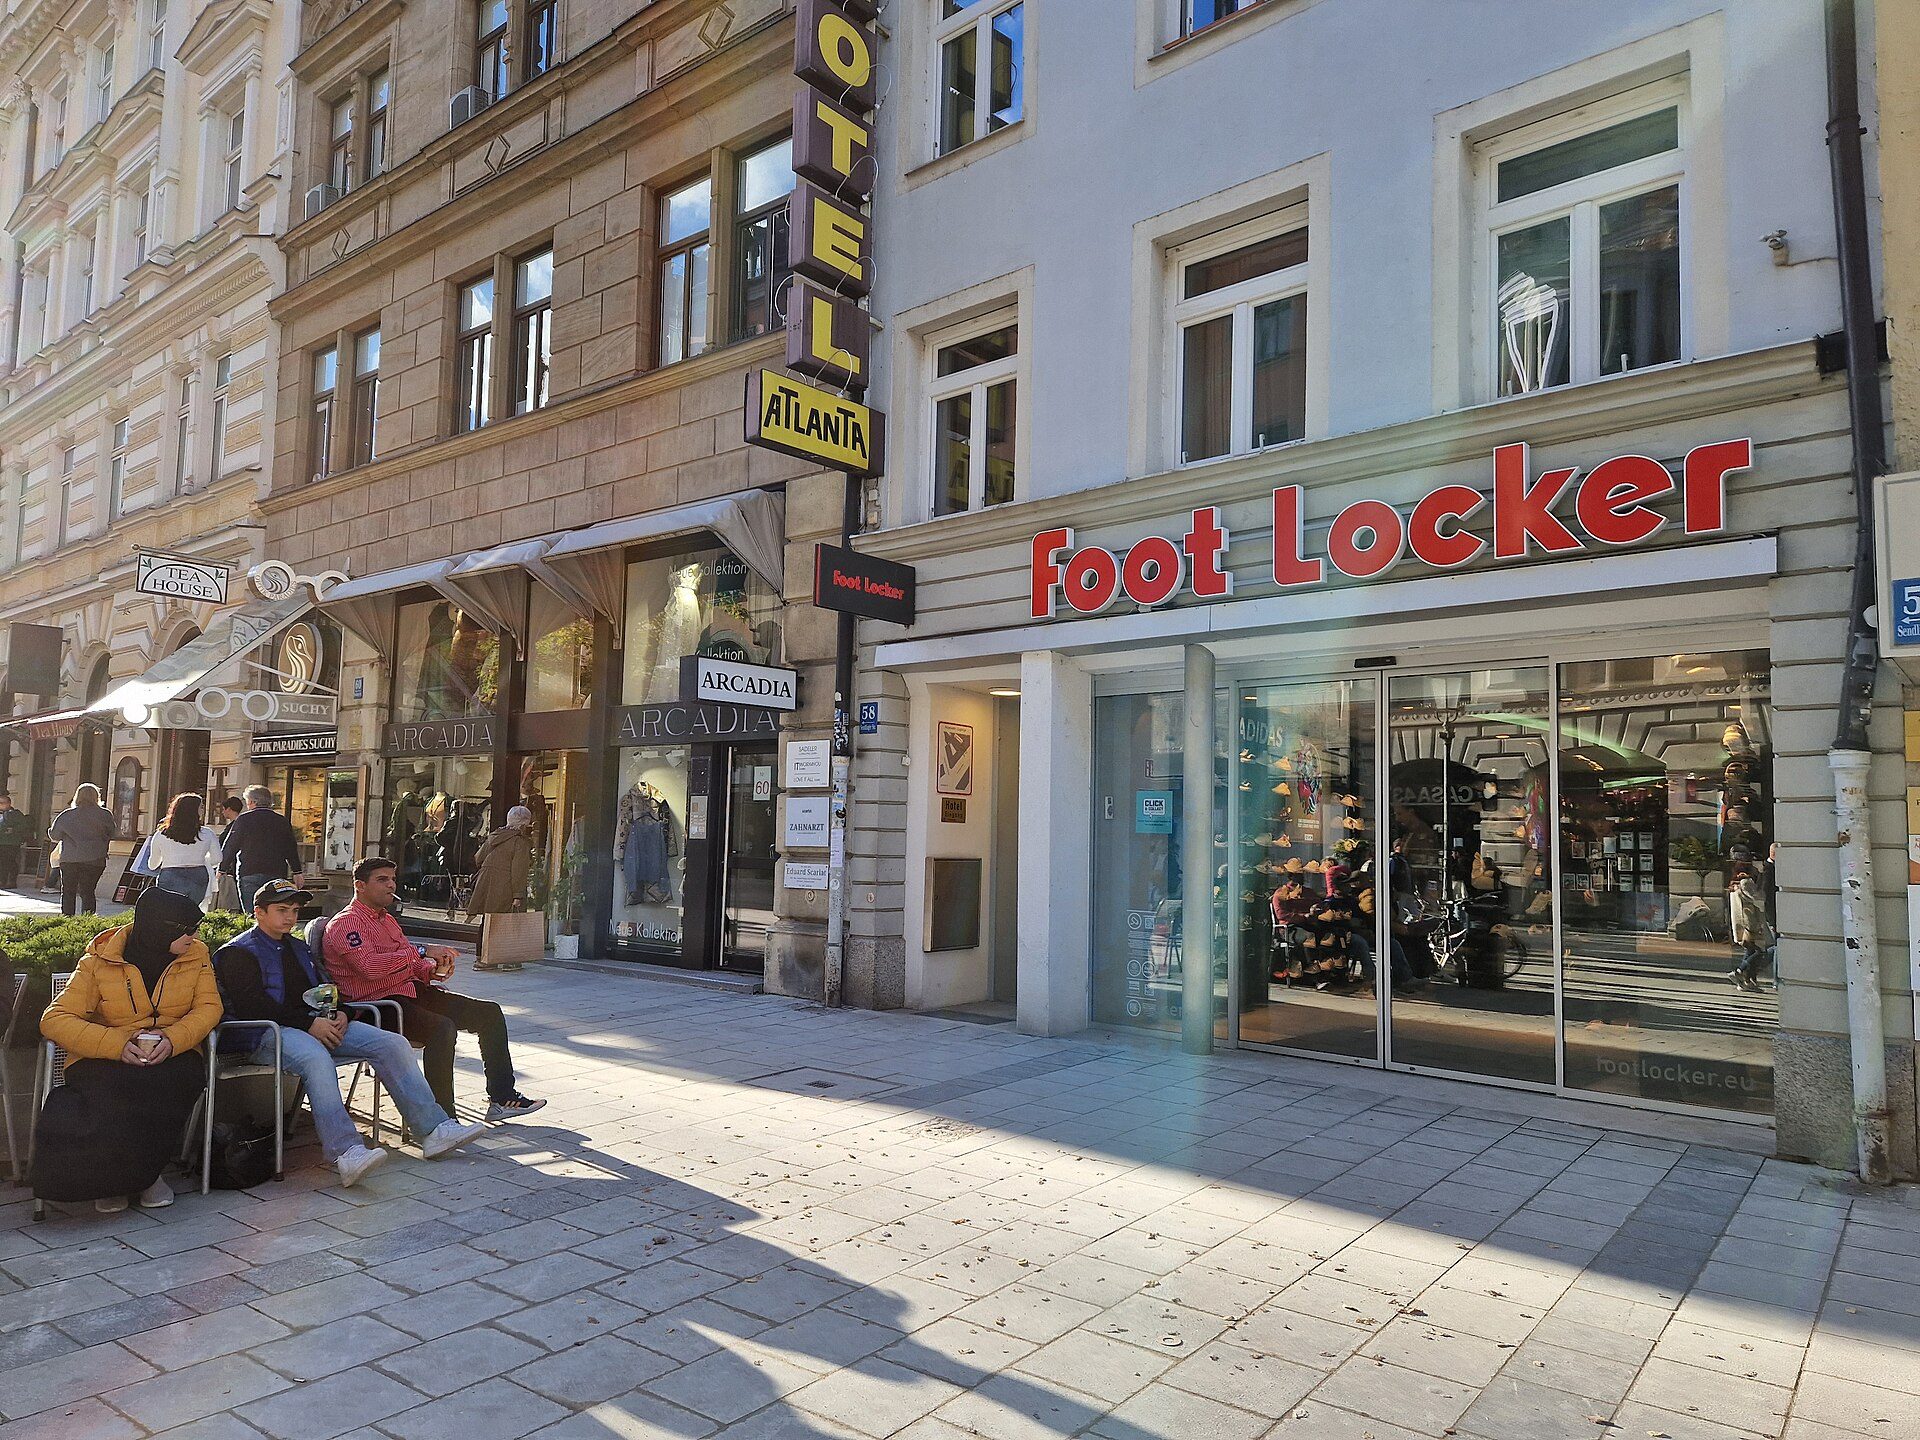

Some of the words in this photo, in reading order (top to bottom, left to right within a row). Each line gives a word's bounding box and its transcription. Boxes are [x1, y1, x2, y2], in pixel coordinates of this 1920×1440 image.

[815, 0, 871, 374] OTEL
[763, 386, 867, 459] ATLANTA
[1030, 505, 1234, 619] Foot
[1272, 436, 1754, 586] Locker
[165, 567, 201, 583] TEA
[833, 569, 861, 591] Foot
[864, 576, 905, 600] Locker
[152, 578, 213, 598] HOUSE
[1897, 624, 1920, 638] Sendl
[701, 671, 792, 699] ARCADIA
[281, 702, 330, 716] SUCHY
[861, 705, 876, 720] 58
[617, 705, 777, 739] ARCADIA
[1239, 716, 1284, 748] ADIDAS
[251, 741, 272, 753] OPTIK
[272, 739, 309, 752] PARADIES
[309, 736, 337, 750] SUCHY
[388, 723, 493, 752] ARCADIA
[755, 780, 770, 795] 60
[945, 800, 963, 811] Hotel
[789, 823, 825, 831] ZAHNARZT
[786, 867, 806, 876] Eduard
[608, 918, 633, 937] Neue
[636, 921, 683, 944] Kollektion
